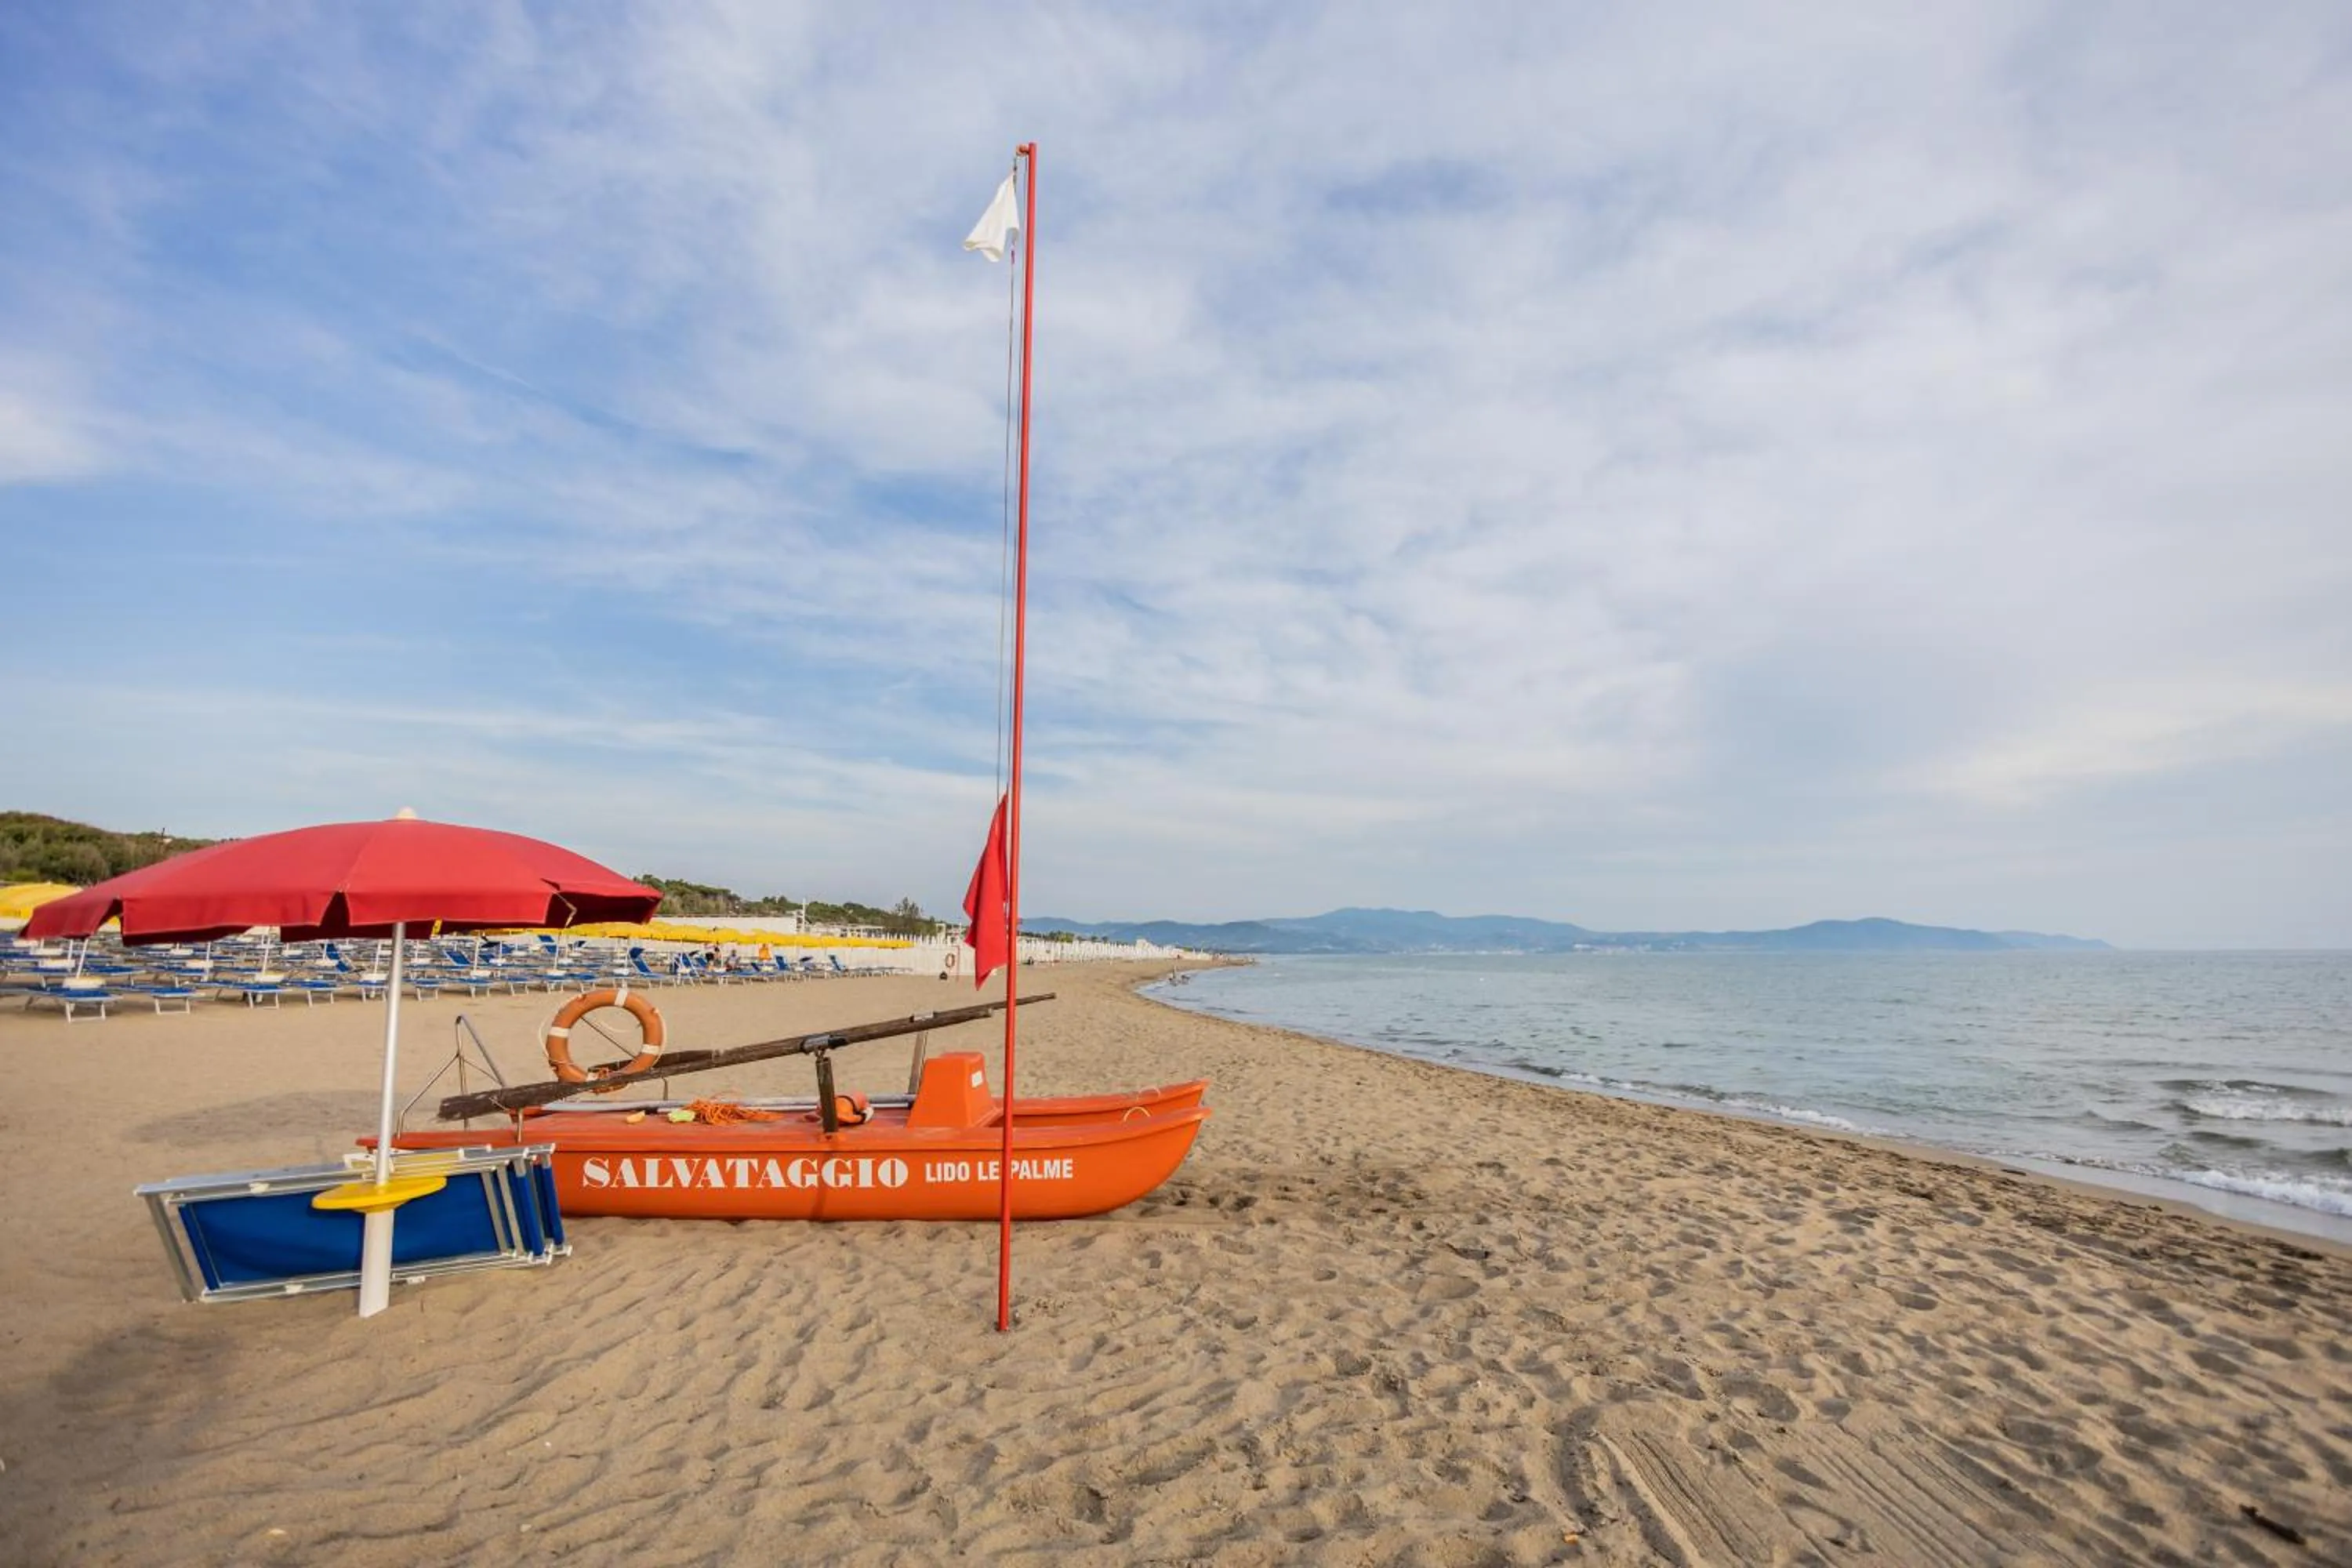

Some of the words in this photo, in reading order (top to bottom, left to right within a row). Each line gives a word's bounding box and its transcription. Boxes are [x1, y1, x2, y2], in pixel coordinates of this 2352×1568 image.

[583, 1156, 909, 1189] SALVATAGGIO
[925, 1161, 970, 1182] LIDO
[978, 1160, 1000, 1181] LE
[1011, 1158, 1073, 1180] PALME
